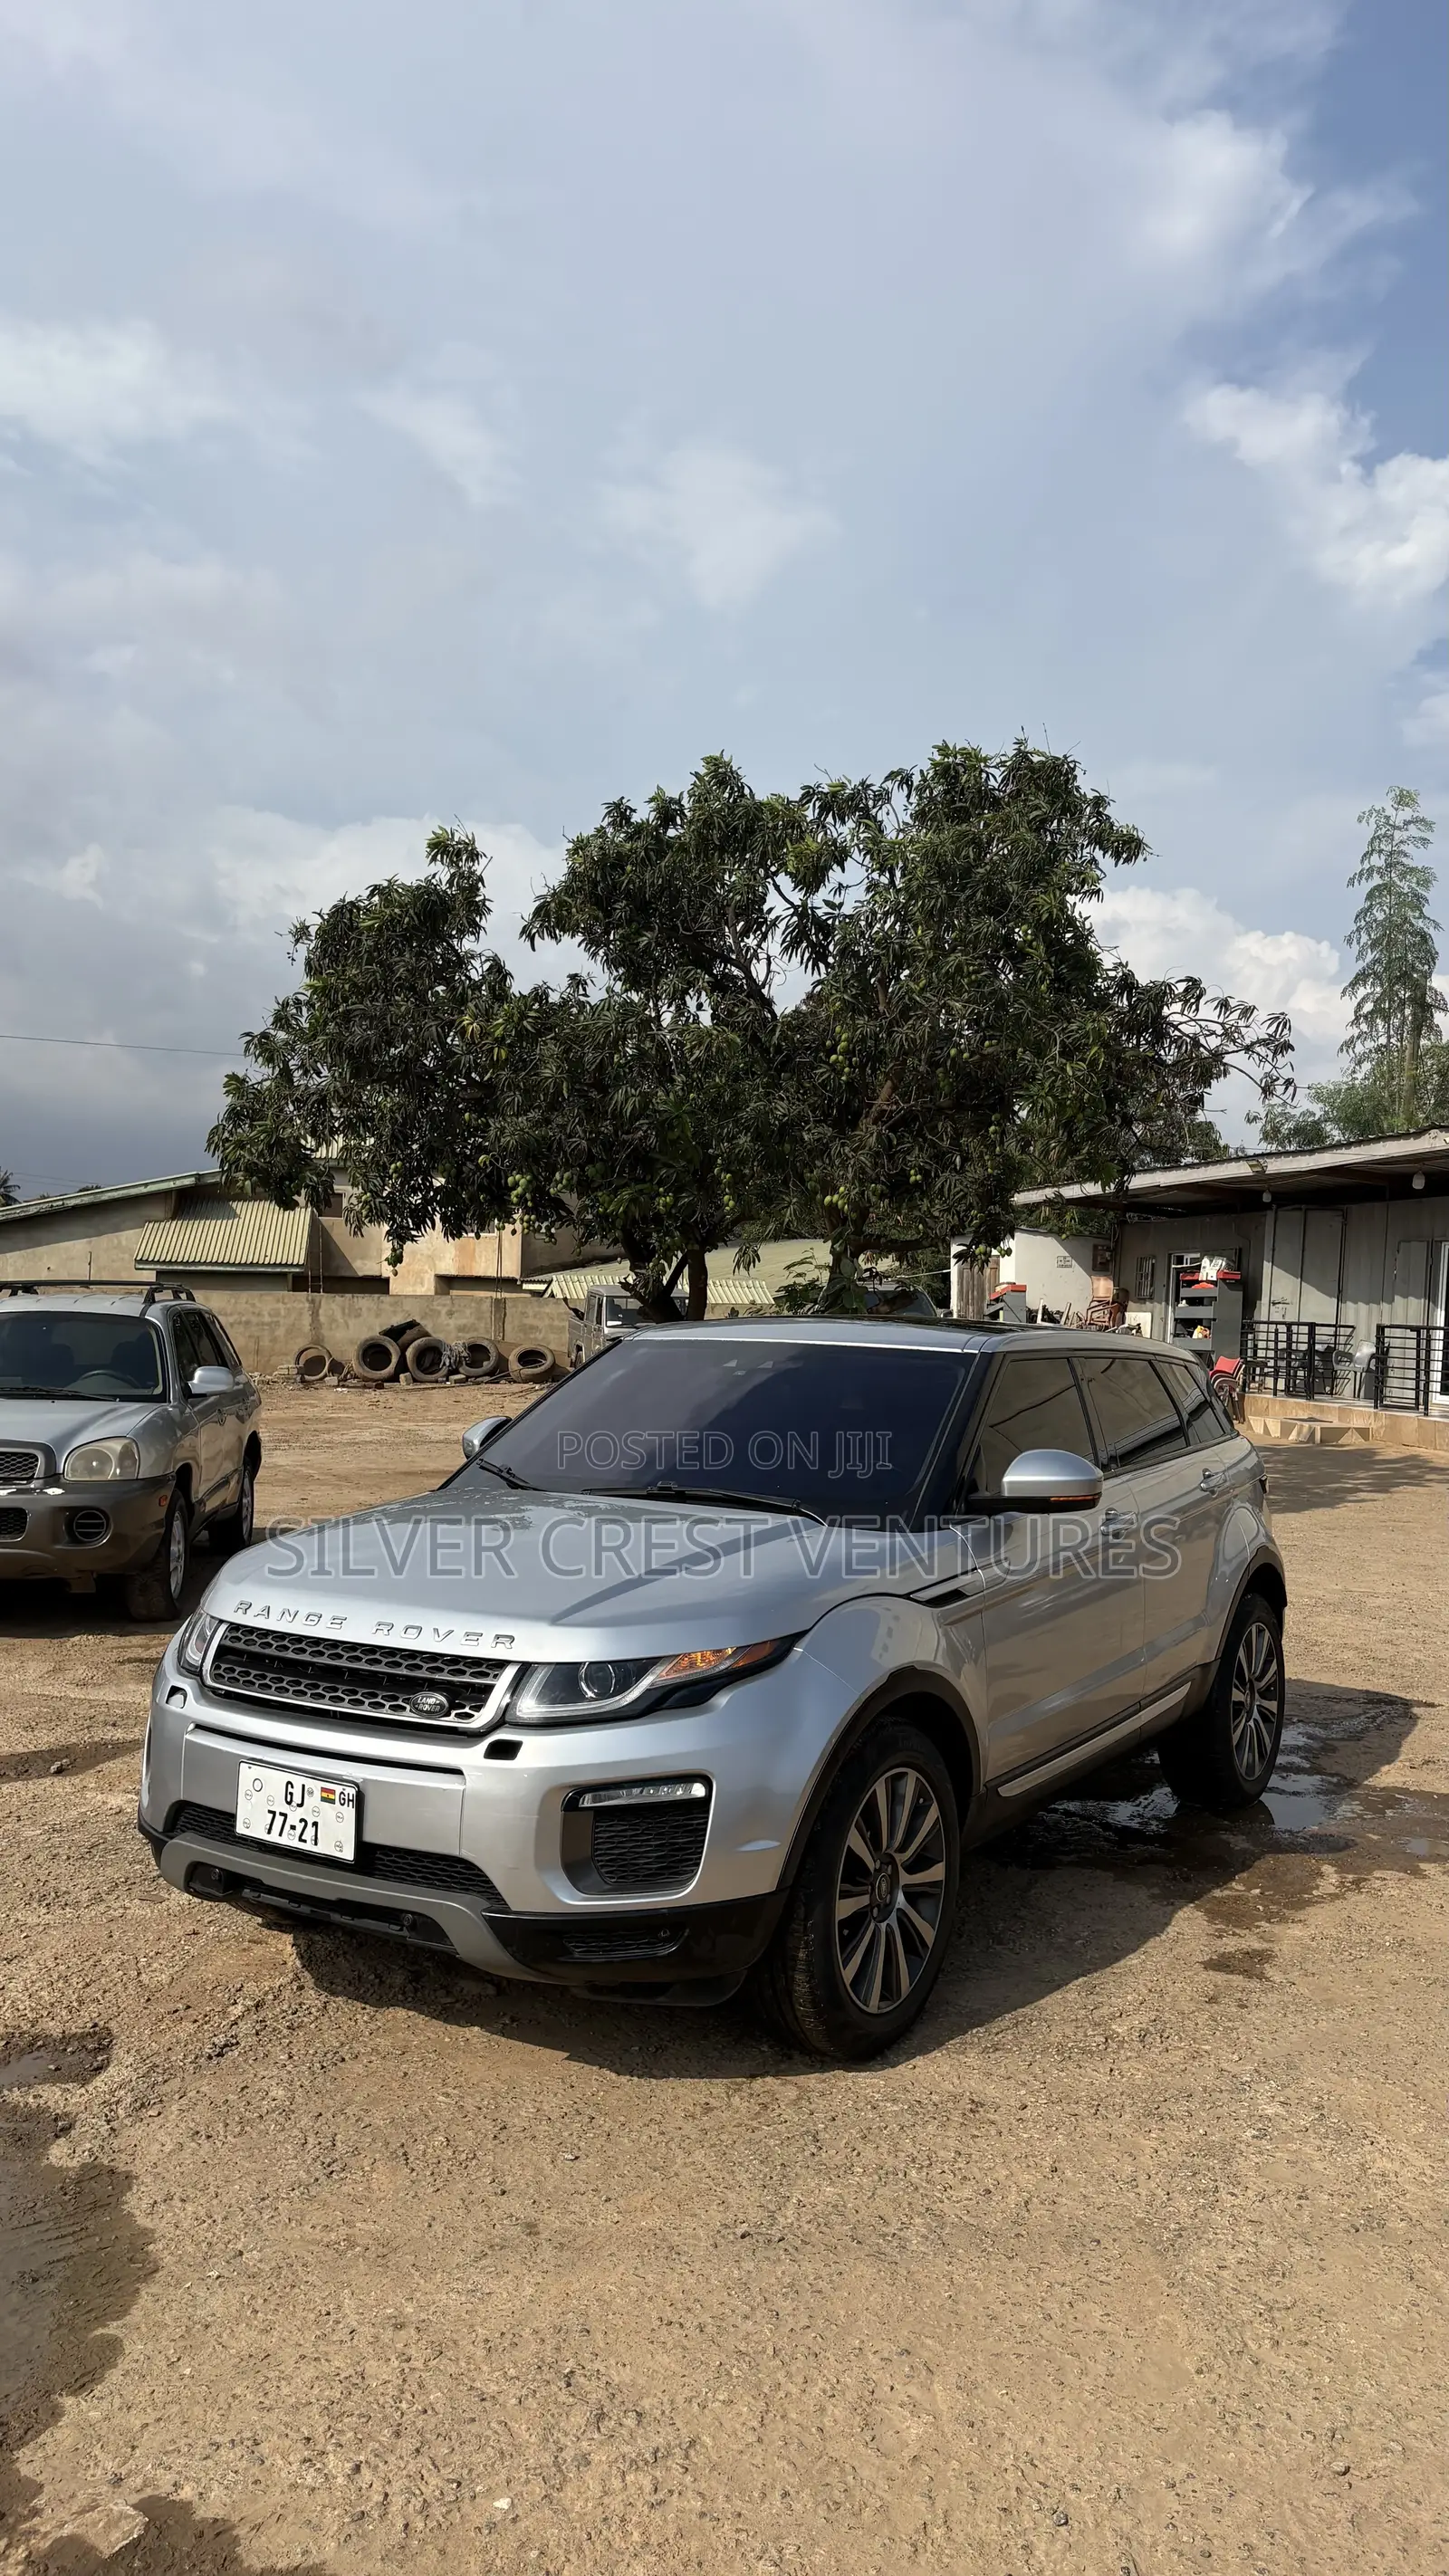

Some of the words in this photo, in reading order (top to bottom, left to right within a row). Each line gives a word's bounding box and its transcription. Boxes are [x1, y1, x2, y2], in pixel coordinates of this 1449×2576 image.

[234, 1600, 348, 1630] RANGE
[371, 1621, 515, 1649] ROVER
[417, 1696, 437, 1705] LAND
[417, 1704, 441, 1712] ROVER
[284, 1780, 306, 1808] GJ
[338, 1791, 355, 1809] GH
[267, 1809, 319, 1846] 77-21
